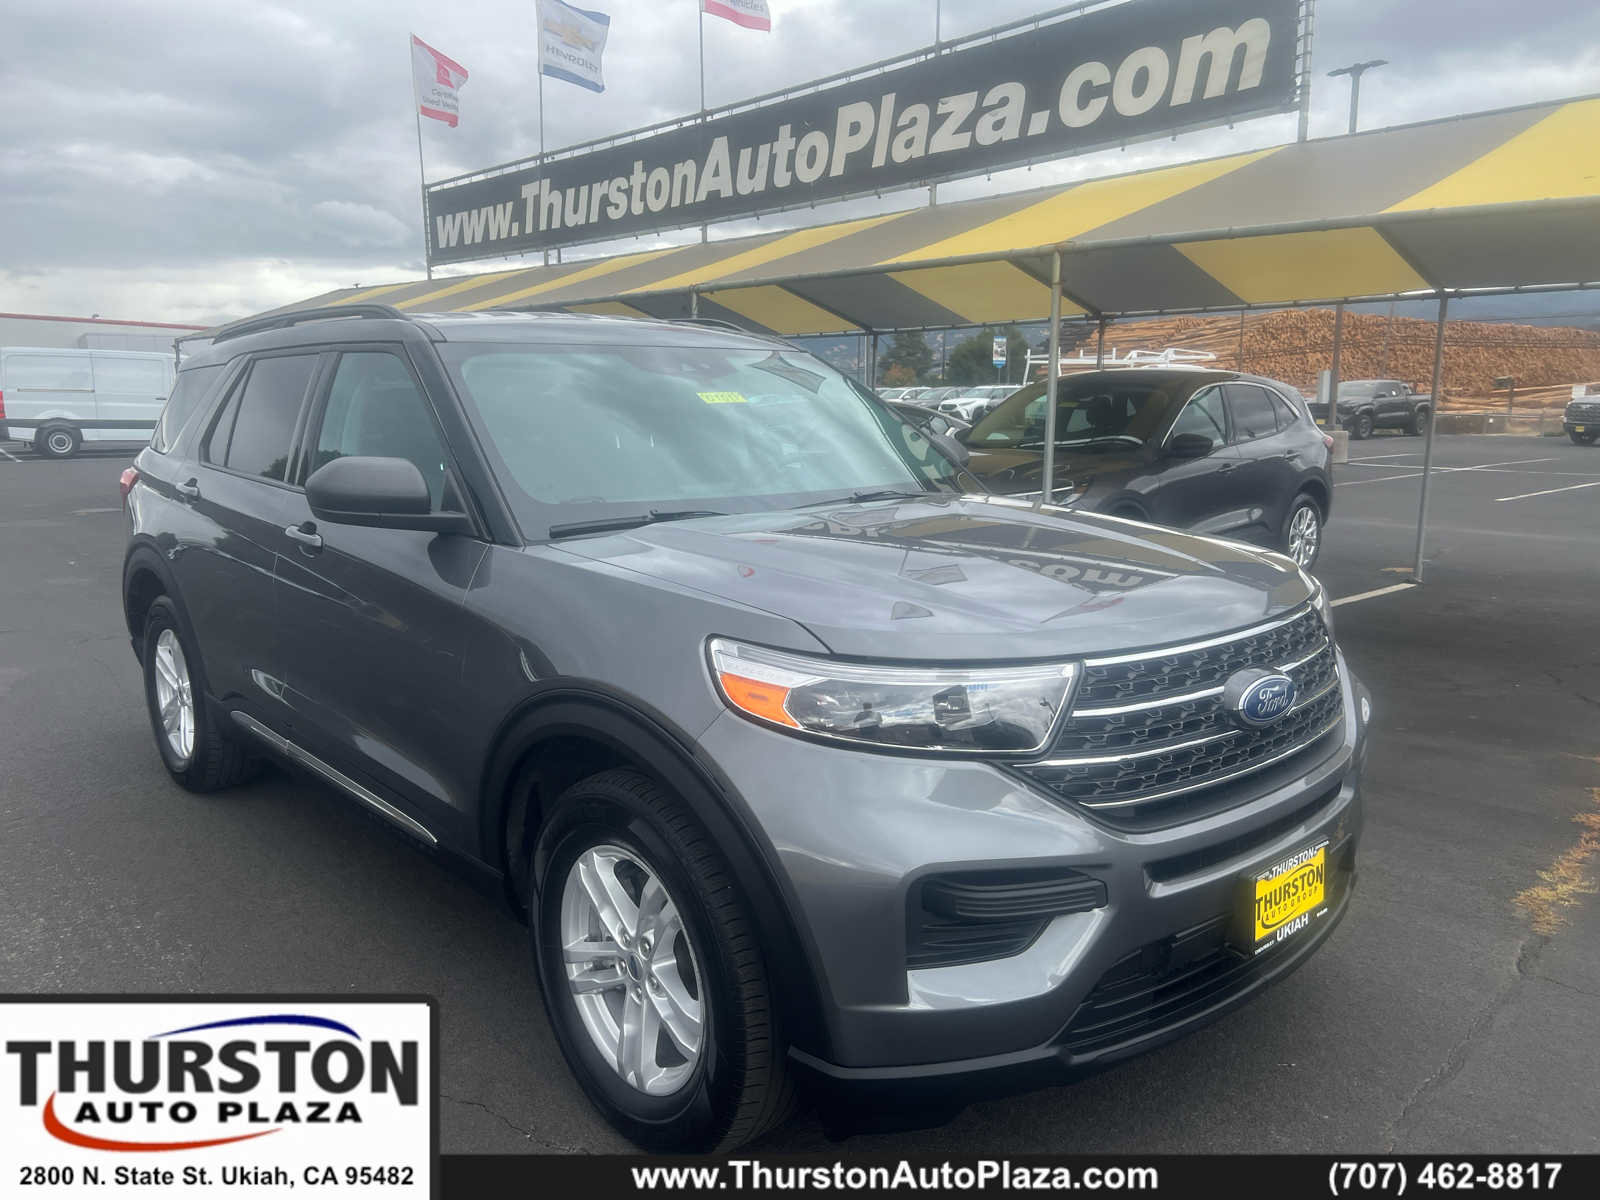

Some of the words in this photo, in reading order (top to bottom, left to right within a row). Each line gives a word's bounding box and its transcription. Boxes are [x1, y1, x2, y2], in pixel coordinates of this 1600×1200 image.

[436, 17, 1271, 249] www.ThurstonAutoPlaza.com
[1257, 685, 1289, 714] Ford
[1271, 847, 1315, 878] THURSTON
[1255, 863, 1324, 921] THURSTON
[1276, 913, 1309, 942] UKIAH
